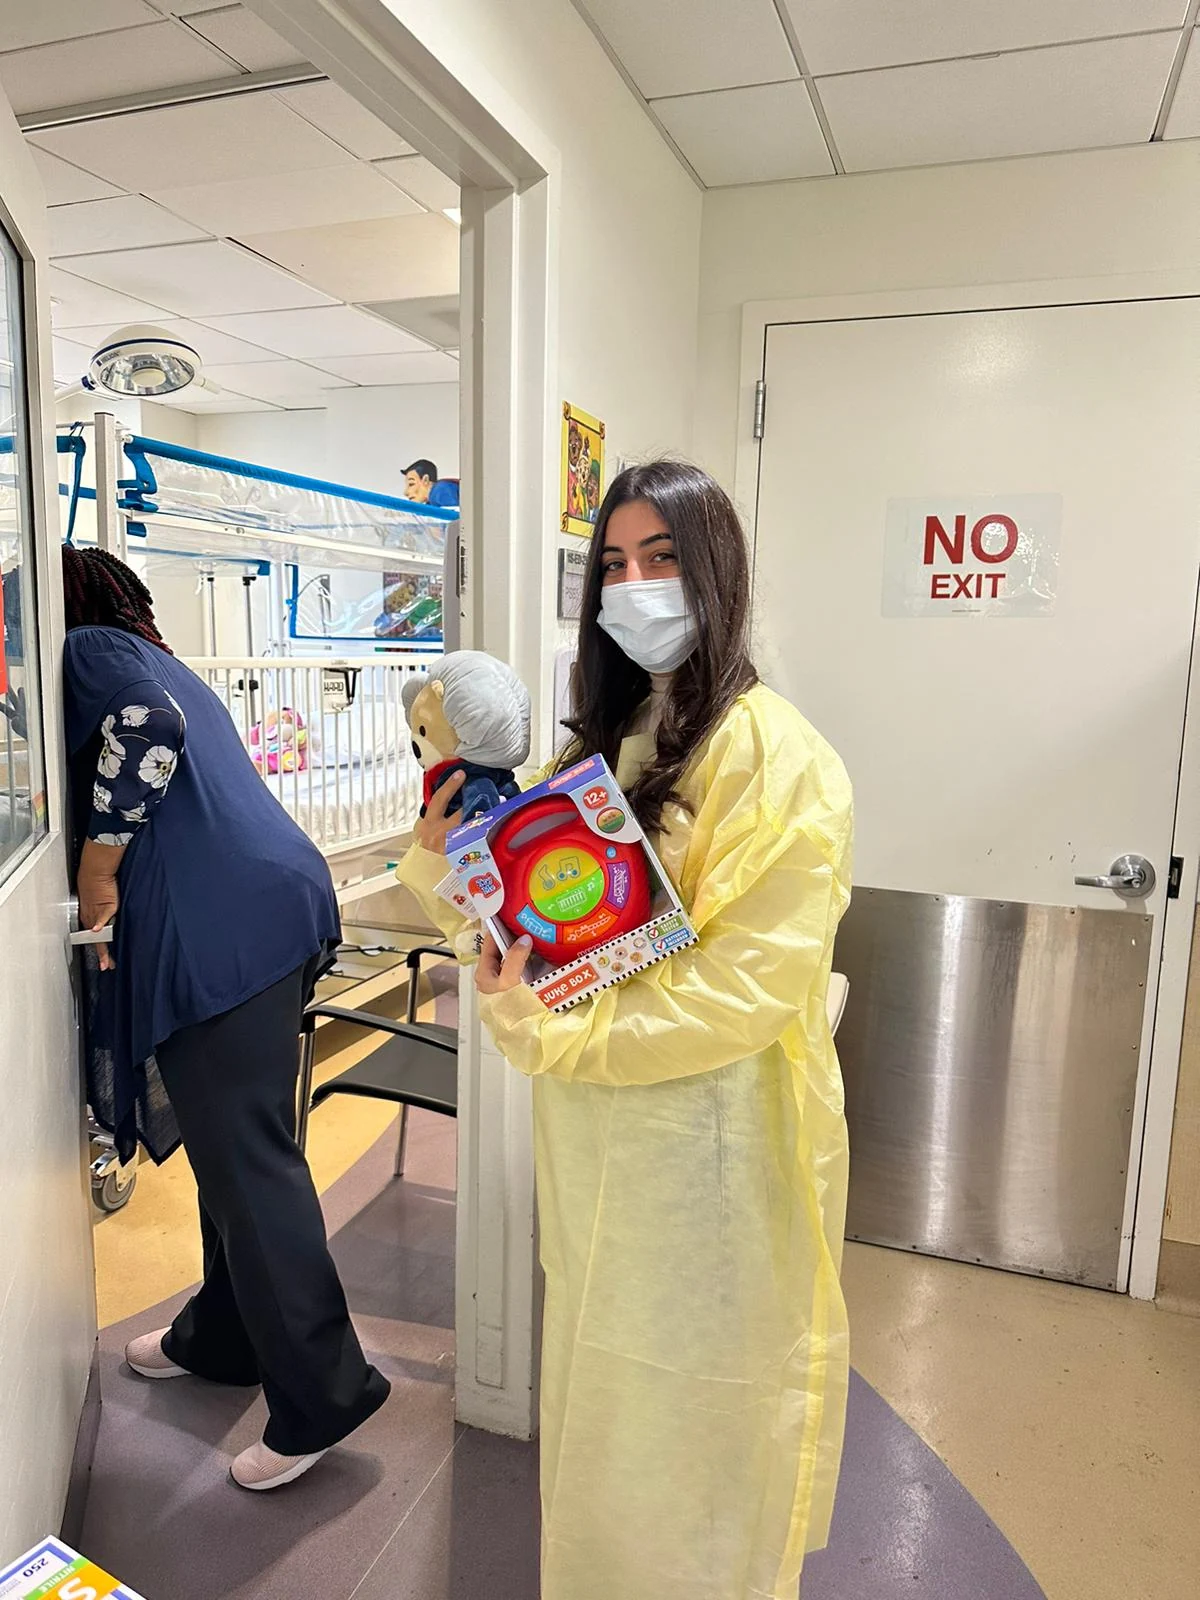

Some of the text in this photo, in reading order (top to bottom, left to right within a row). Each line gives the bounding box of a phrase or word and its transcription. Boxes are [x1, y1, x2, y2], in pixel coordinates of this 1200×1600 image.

[923, 514, 1019, 565] NO
[930, 573, 1006, 599] EXIT
[583, 790, 607, 805] 12+
[569, 969, 593, 987] BOX
[22, 1557, 49, 1578] 250
